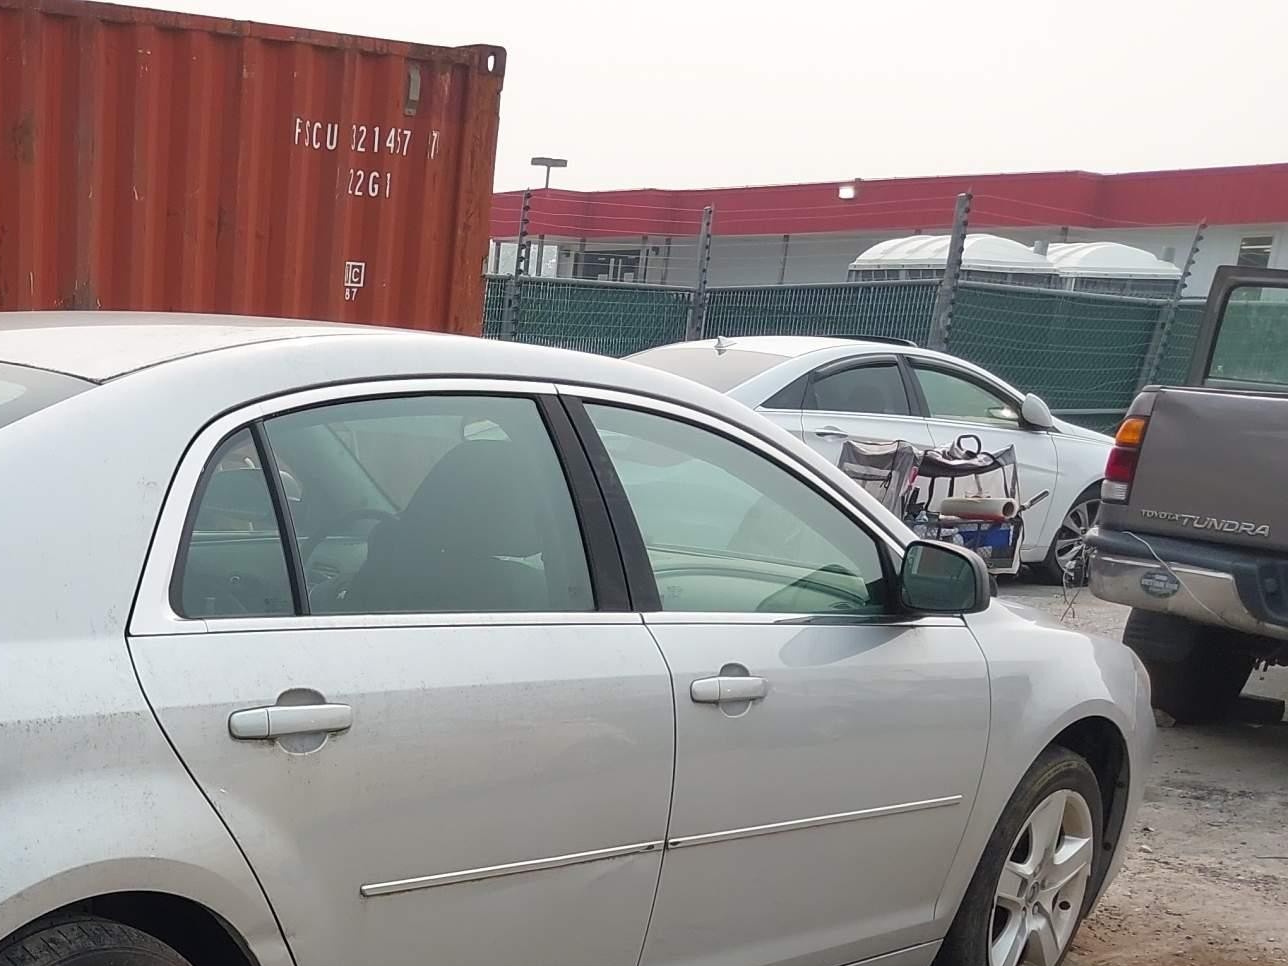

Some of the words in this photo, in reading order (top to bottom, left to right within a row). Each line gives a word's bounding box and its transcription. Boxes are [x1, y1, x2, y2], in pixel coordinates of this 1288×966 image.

[347, 167, 392, 199] 22G1
[344, 287, 359, 301] 87
[1140, 508, 1179, 521] TOYOTA
[1180, 513, 1271, 537] TUNDRA
